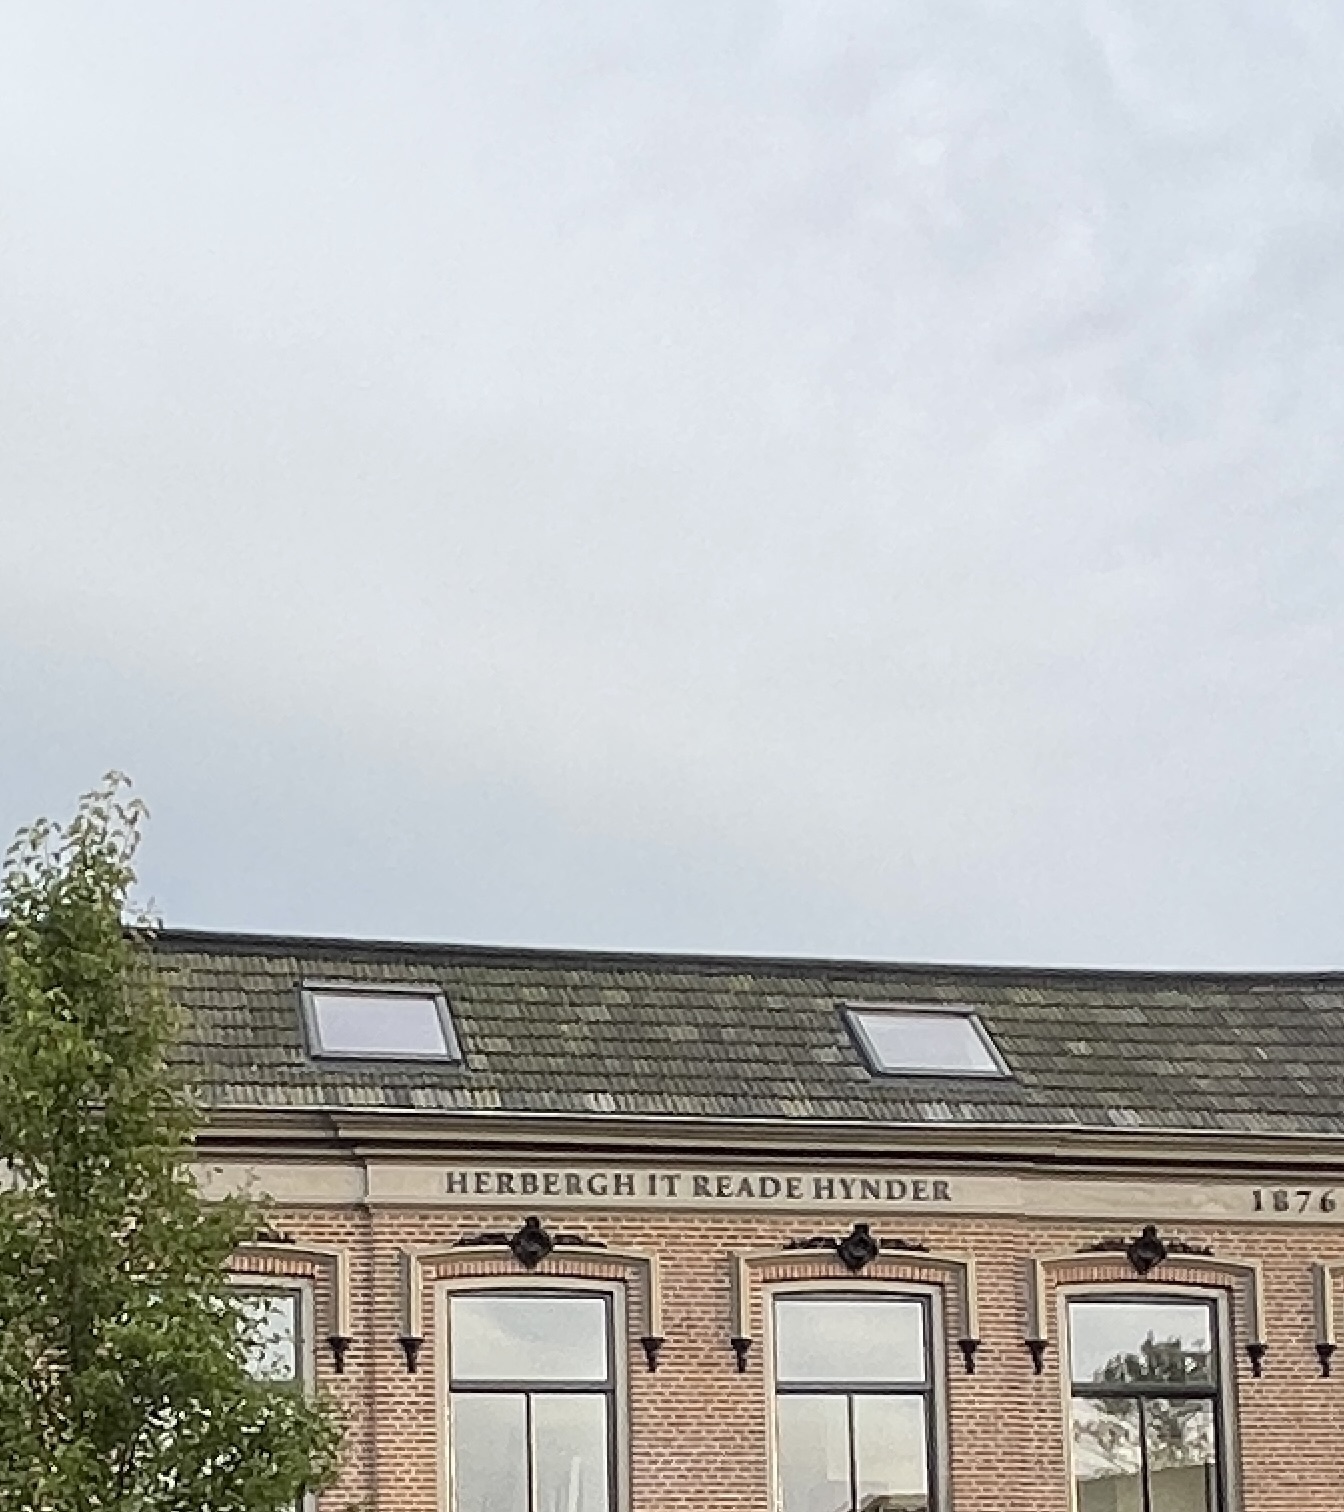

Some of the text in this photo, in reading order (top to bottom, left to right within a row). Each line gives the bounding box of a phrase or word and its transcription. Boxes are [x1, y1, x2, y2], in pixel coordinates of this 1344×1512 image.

[444, 1171, 953, 1202] HERBERGH IT READE HYNDER
[1252, 1188, 1336, 1214] 1876
